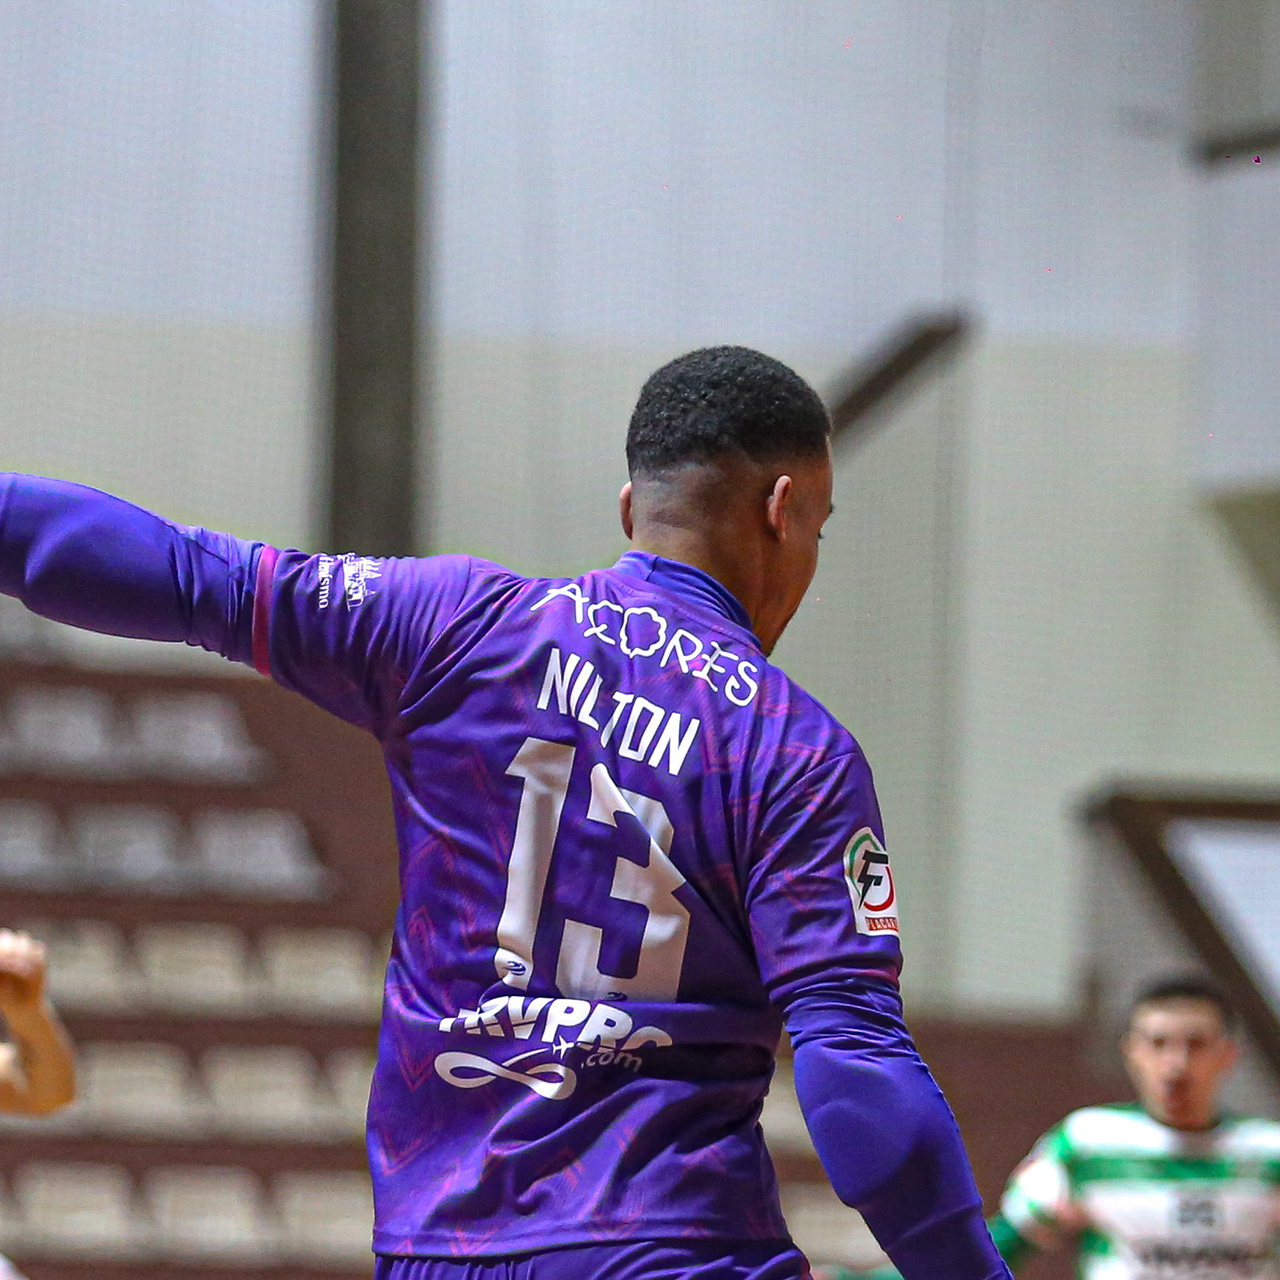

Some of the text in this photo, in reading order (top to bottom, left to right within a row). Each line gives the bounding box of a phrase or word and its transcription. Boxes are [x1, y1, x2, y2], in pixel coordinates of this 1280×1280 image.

[529, 583, 759, 707] AÇORES
[536, 647, 701, 776] NILTON
[494, 736, 691, 1003] 13
[580, 1049, 643, 1073] .com
